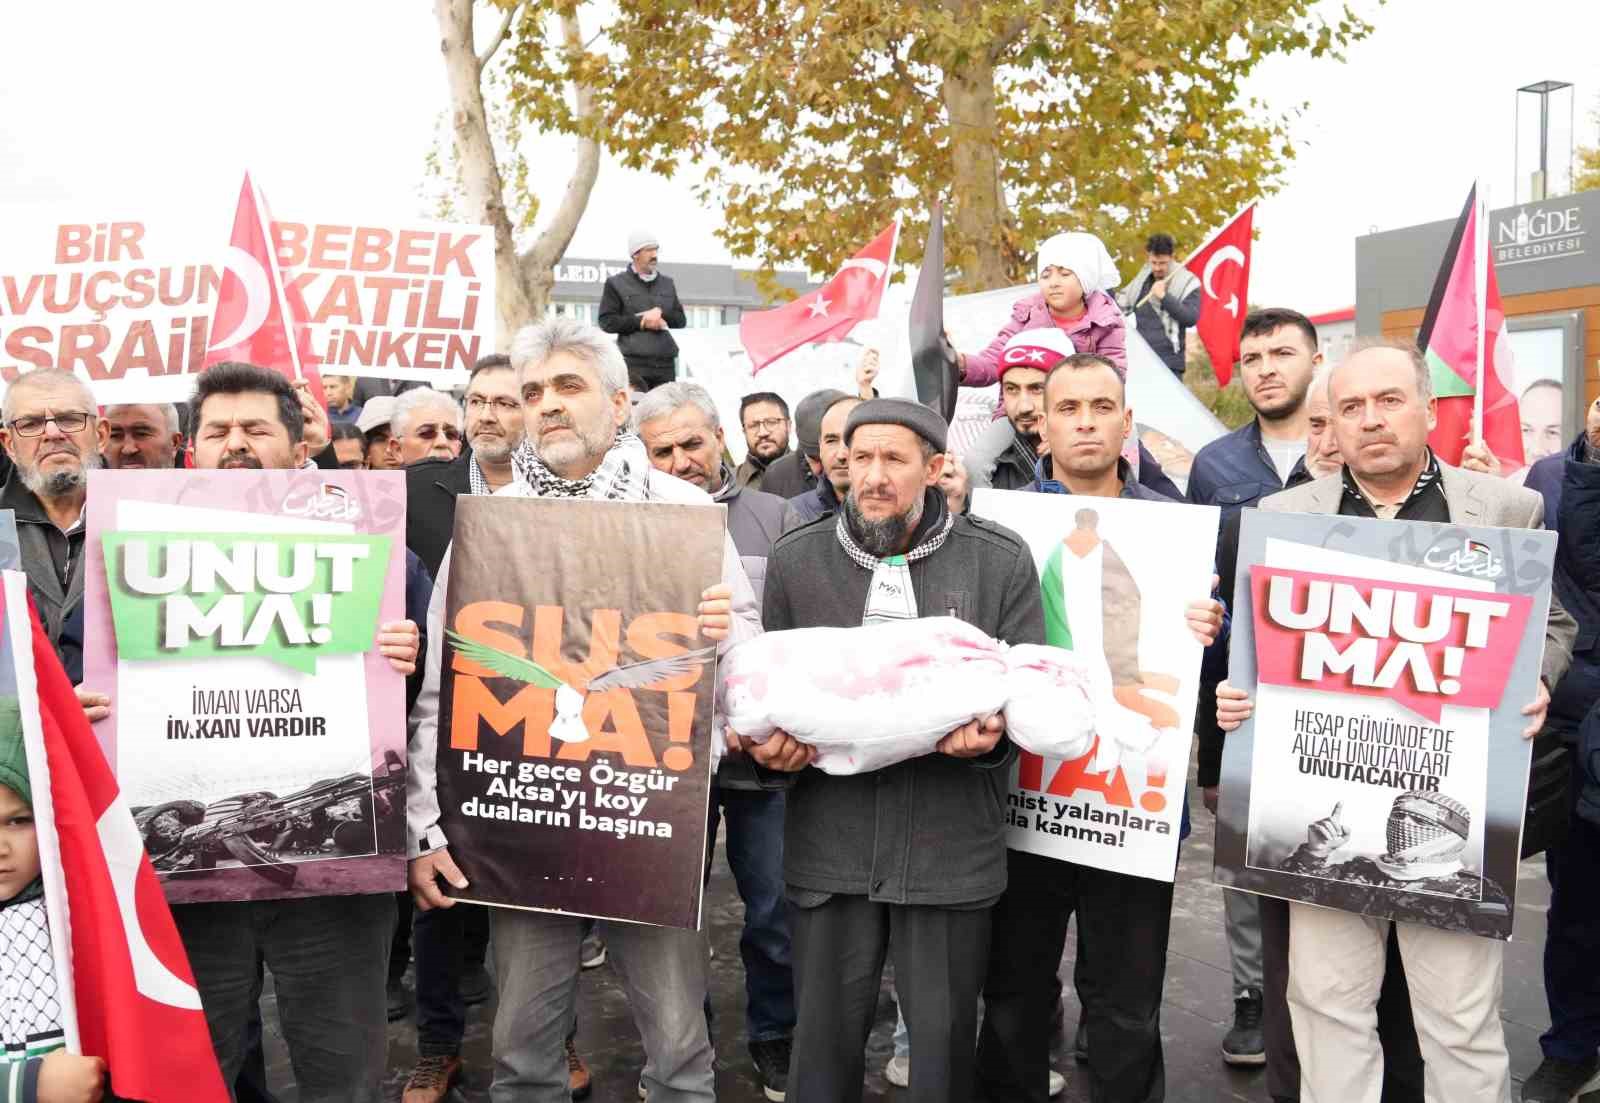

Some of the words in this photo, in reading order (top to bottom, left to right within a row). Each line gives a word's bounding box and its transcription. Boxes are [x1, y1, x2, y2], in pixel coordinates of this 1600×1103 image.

[273, 221, 481, 277] BEBEK
[0, 264, 221, 322] VUÇSUN
[124, 540, 369, 594] UNUT
[165, 593, 332, 648] MA!
[1268, 575, 1511, 648] UNUT
[452, 601, 703, 691] SUS
[1301, 632, 1465, 695] MA!
[192, 686, 240, 715] İMAN
[245, 688, 303, 714] VARSA
[450, 674, 696, 771] MA!
[249, 717, 326, 738] VARDIR
[1294, 709, 1344, 736] HESAP
[1348, 714, 1455, 753] GÜNÜNDE'DE
[462, 752, 511, 775] Her
[518, 760, 581, 784] gece
[589, 759, 679, 794] Özgür
[1292, 733, 1341, 762] ALLAH
[1346, 740, 1450, 777] UNUTANLARI
[1298, 756, 1440, 792] UNUTACAKTIR
[461, 797, 571, 827] duaların
[578, 809, 673, 839] başına
[486, 777, 586, 810] Aksa'yı
[595, 786, 648, 816] koy
[1054, 802, 1171, 835] yalanlara
[1035, 814, 1126, 848] kanma!
